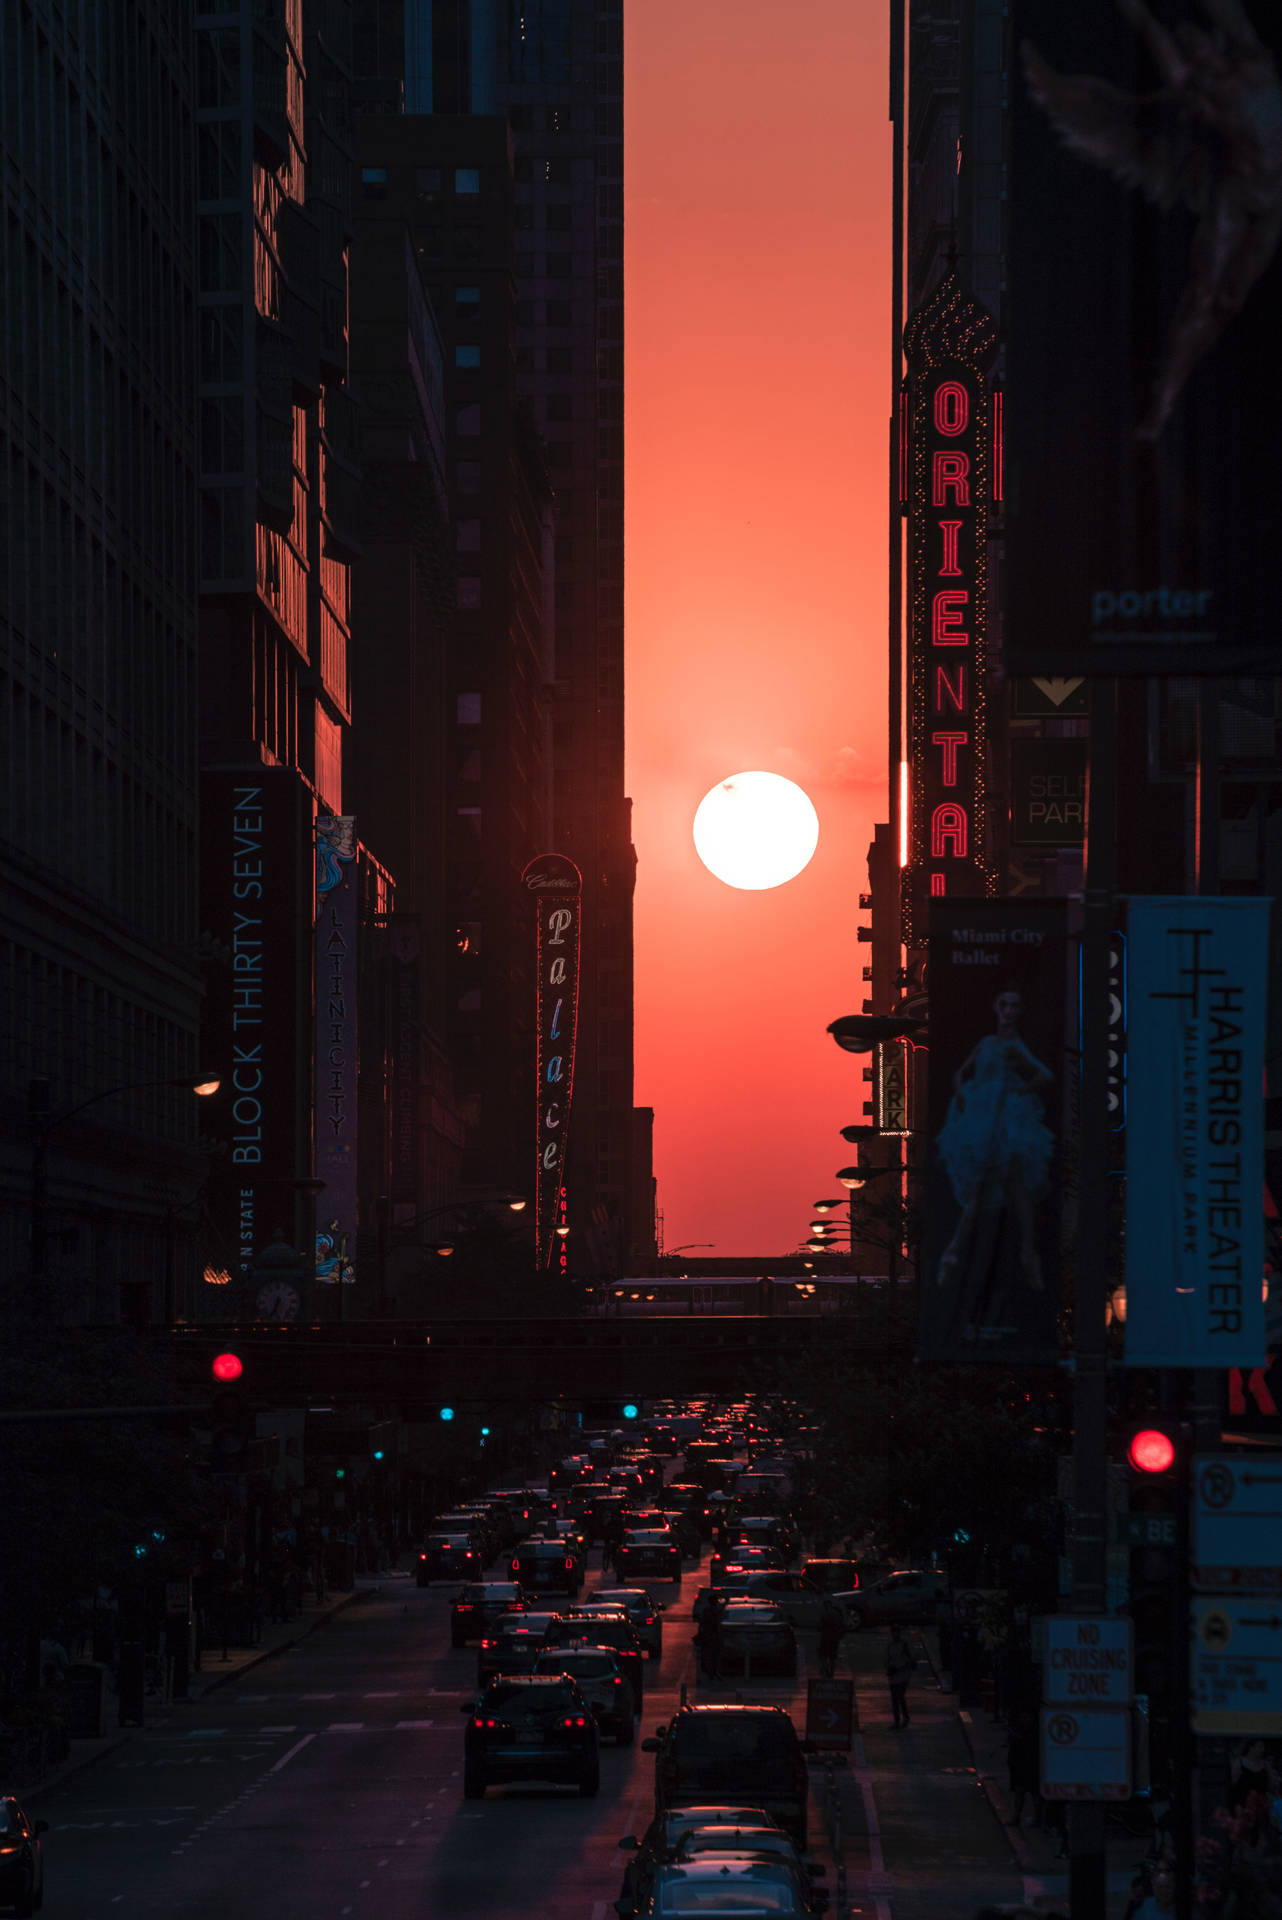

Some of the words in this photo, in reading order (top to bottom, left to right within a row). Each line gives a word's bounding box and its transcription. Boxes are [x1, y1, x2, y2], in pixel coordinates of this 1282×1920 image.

[1090, 585, 1213, 624] porter
[232, 787, 264, 900] SEVEN
[1028, 801, 1083, 824] PAR
[952, 928, 1007, 944] Miami
[1010, 928, 1047, 949] City
[952, 948, 1001, 965] Ballet
[232, 912, 264, 1031] THIRTY
[327, 909, 346, 1135] LATINICITY
[543, 908, 572, 1169] Palace
[1207, 987, 1243, 1146] HARRIS
[232, 1042, 264, 1164] BLOCK
[1183, 1025, 1198, 1180] MILLENNIUM
[240, 1188, 255, 1241] STATE
[1183, 1191, 1198, 1256] PARK
[1207, 1153, 1243, 1335] THEATER
[1051, 1648, 1129, 1671] CRUISING
[1077, 1623, 1100, 1646] NO
[1066, 1672, 1112, 1695] ZONE
